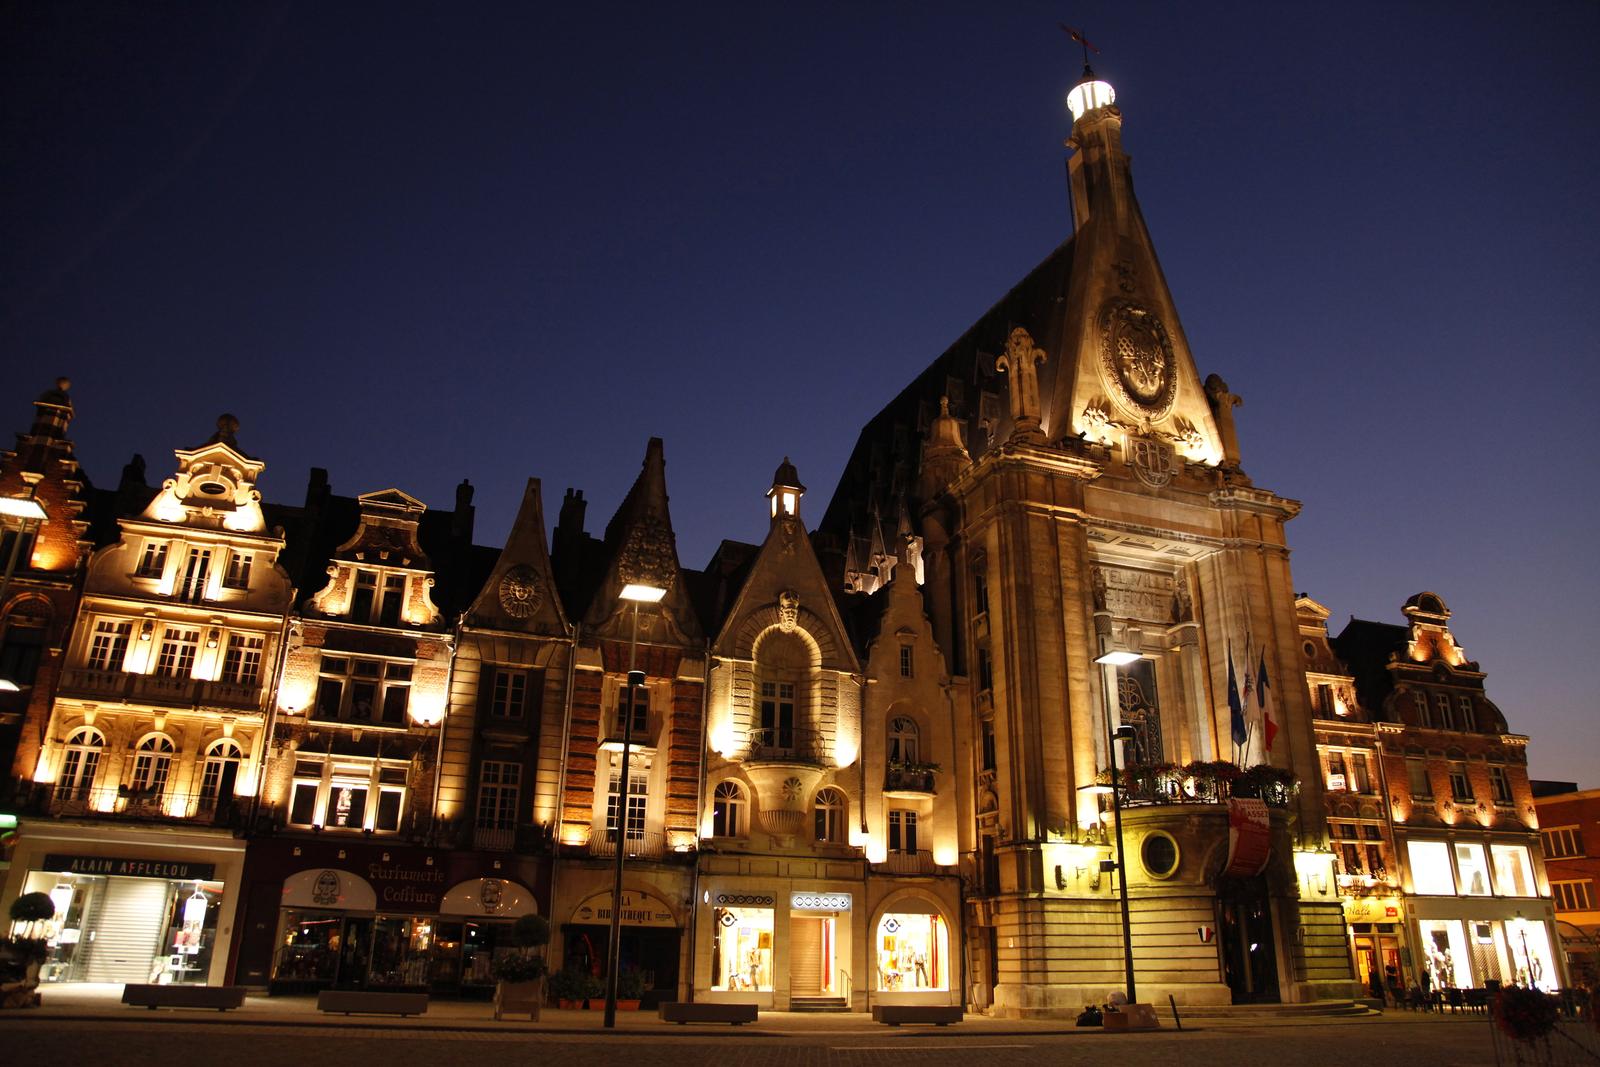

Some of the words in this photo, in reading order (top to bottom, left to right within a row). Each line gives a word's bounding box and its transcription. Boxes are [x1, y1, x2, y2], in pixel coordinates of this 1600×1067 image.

[71, 858, 112, 873] ALAIN
[119, 861, 188, 877] AFFLELOU
[368, 863, 446, 882] Parfumerie
[383, 886, 437, 904] Coiffure
